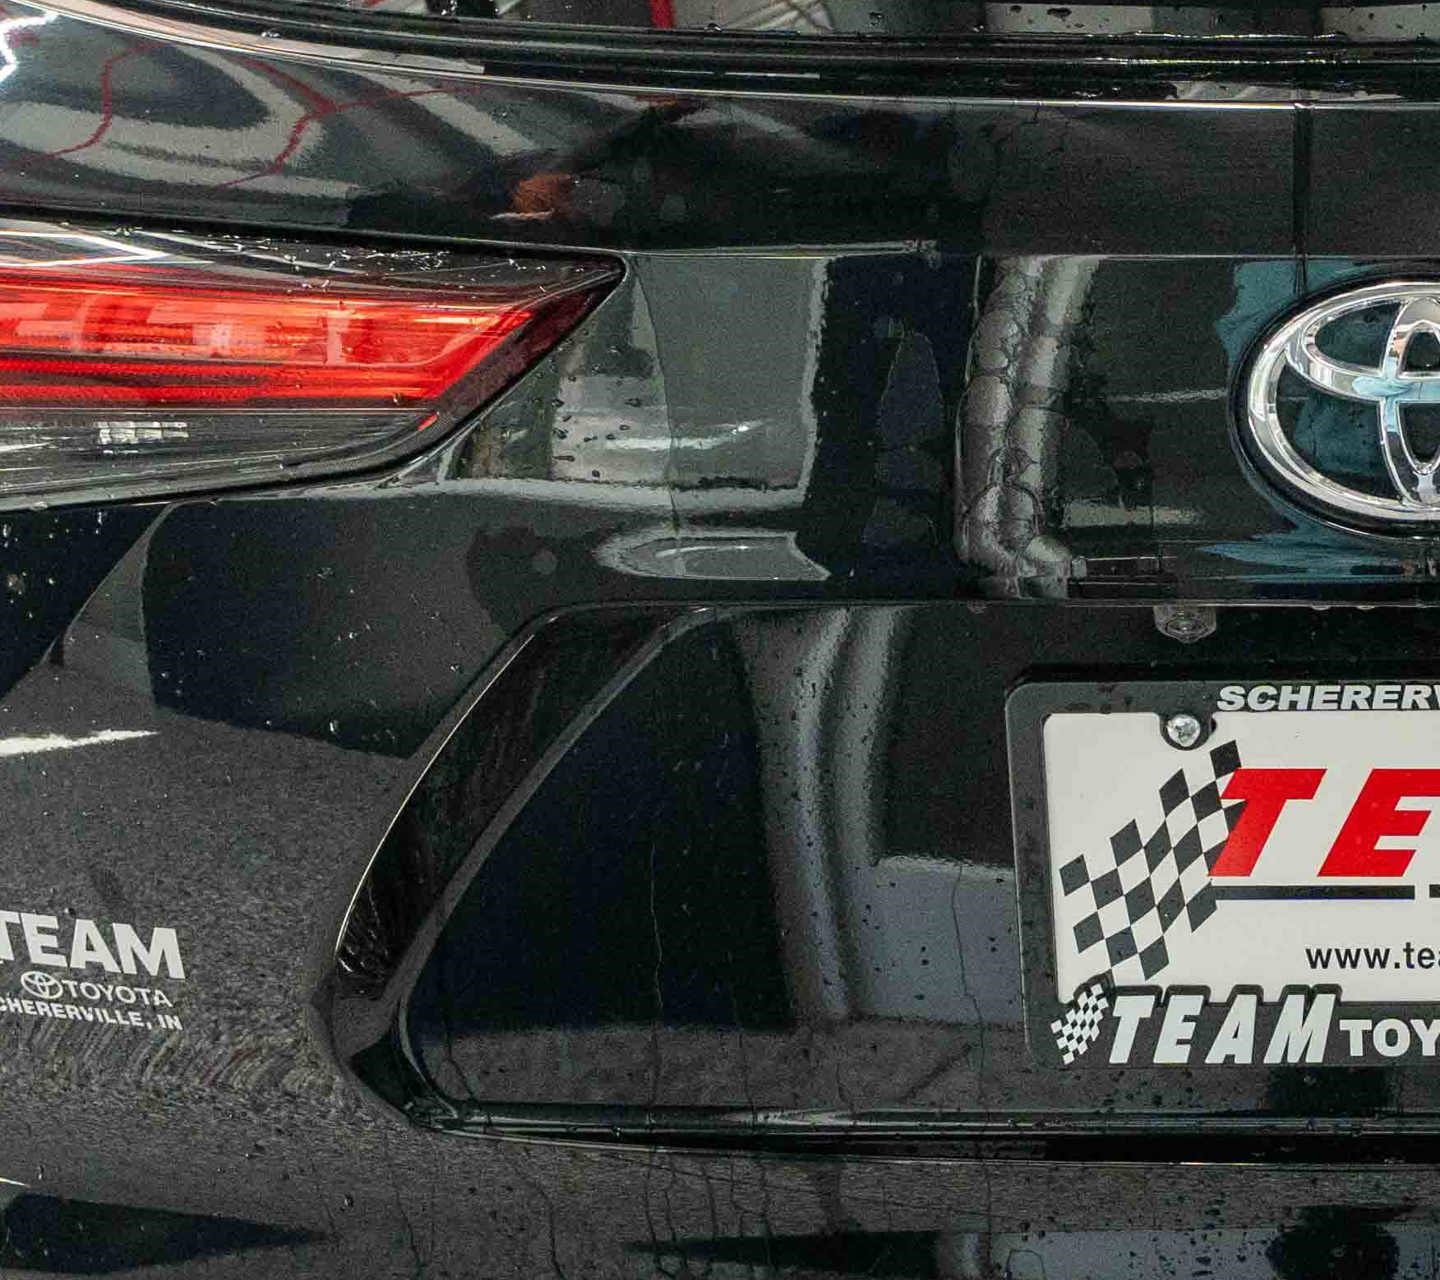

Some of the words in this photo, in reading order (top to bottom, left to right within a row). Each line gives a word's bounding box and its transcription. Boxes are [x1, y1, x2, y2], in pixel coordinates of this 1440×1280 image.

[60, 979, 173, 1008] TOYOTA
[157, 1014, 183, 1030] IN
[1109, 994, 1336, 1065] TEAM
